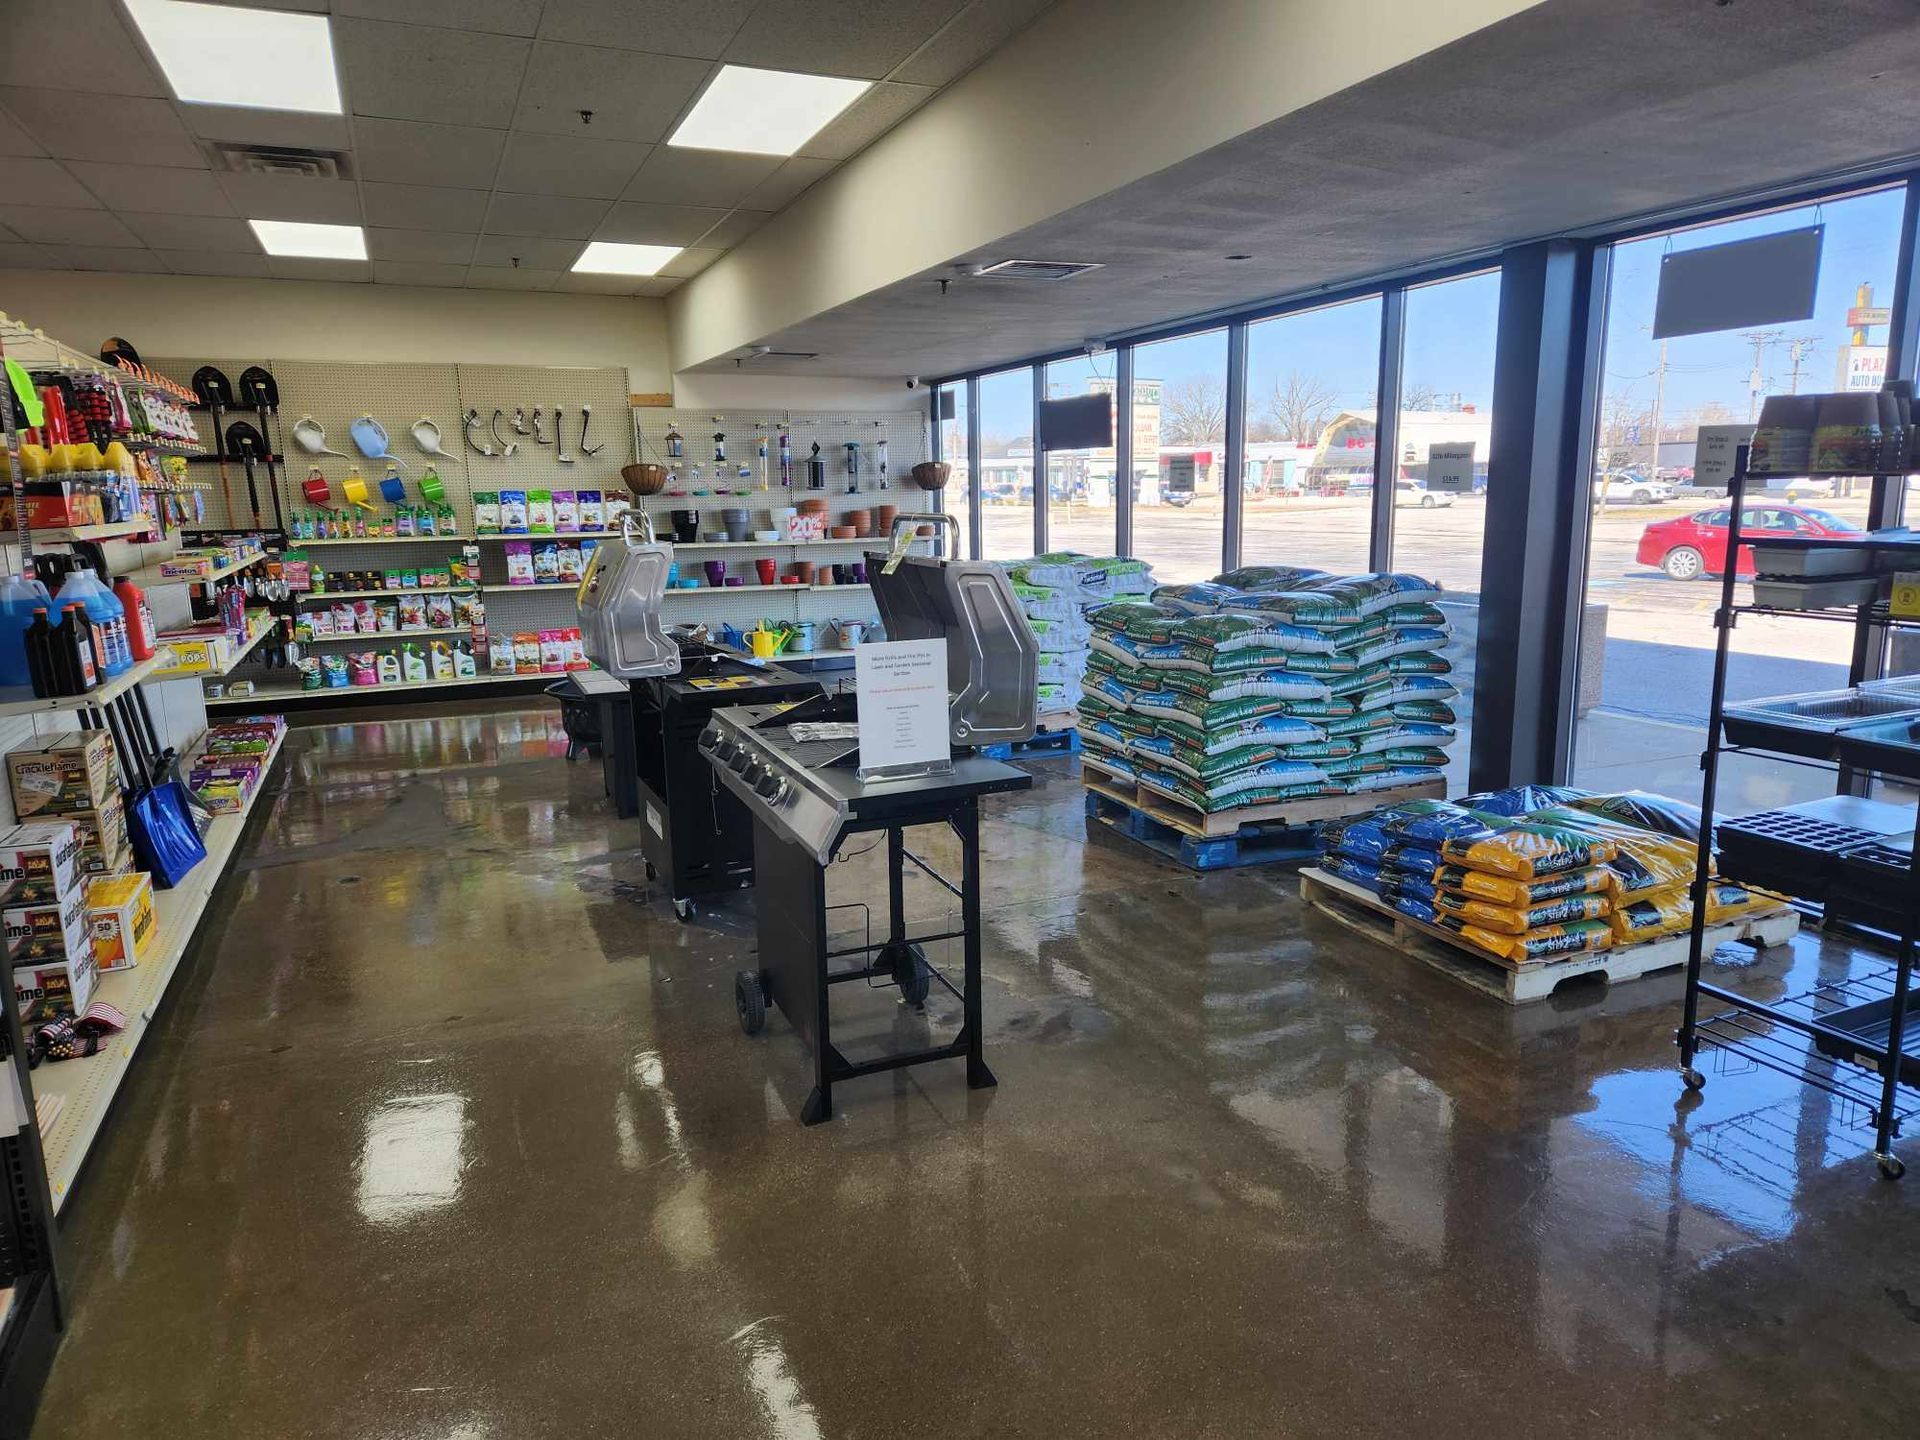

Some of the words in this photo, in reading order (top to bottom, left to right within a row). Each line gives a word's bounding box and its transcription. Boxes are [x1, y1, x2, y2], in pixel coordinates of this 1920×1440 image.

[1862, 357, 1885, 372] PLAZ
[1851, 375, 1869, 387] AUTO
[164, 567, 197, 576] mentos
[1231, 628, 1266, 639] Milorganite
[181, 652, 206, 662] POPS
[1223, 676, 1258, 686] Milorganite
[1201, 763, 1235, 777] Milorganite
[97, 922, 112, 933] 50
